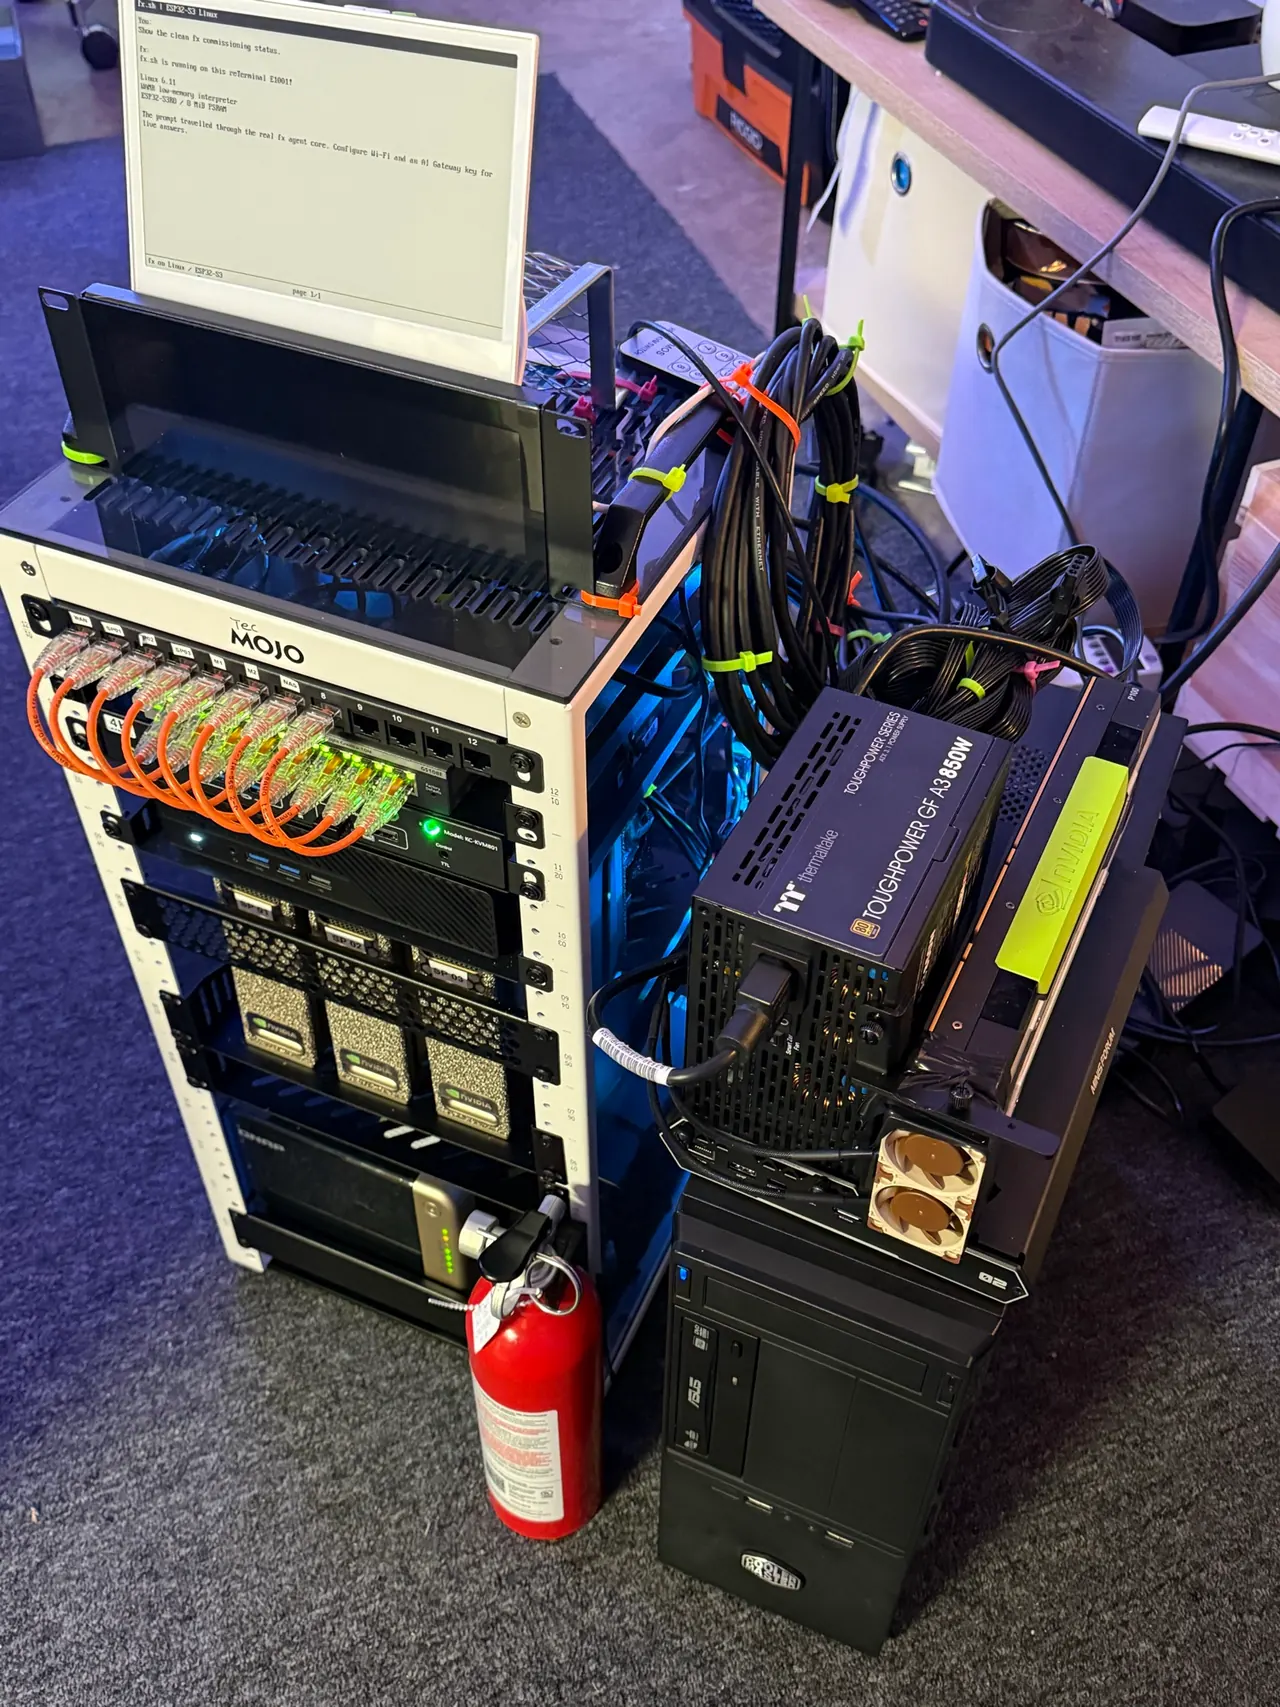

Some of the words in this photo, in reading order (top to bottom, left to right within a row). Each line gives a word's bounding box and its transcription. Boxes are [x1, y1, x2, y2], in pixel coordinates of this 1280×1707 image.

[166, 3, 196, 15] ESP32-S3
[199, 9, 218, 19] Linux
[138, 17, 152, 25] You:
[138, 27, 153, 35] Show
[156, 29, 168, 38] the
[170, 32, 189, 41] clean
[192, 35, 200, 43] fx
[203, 38, 251, 52] commissioning
[254, 45, 281, 55] status.
[140, 55, 158, 64] fx.sh
[161, 57, 169, 66] is
[171, 61, 197, 72] running
[211, 66, 226, 76] this
[229, 70, 266, 82] reTerminal
[140, 73, 158, 83] Linux
[161, 77, 176, 86] 6.11
[198, 93, 238, 106] interpreter
[208, 103, 227, 113] PSRAM
[143, 120, 157, 128] live
[160, 124, 188, 134] answers.
[142, 110, 153, 119] The
[156, 113, 177, 123] prompt
[180, 117, 213, 129] travelled
[216, 123, 242, 135] through
[245, 125, 256, 136] the
[259, 129, 274, 140] real
[277, 133, 286, 142] fx
[288, 137, 307, 145] agent
[310, 140, 330, 150] core.
[333, 143, 368, 156] Configure
[371, 150, 391, 160] Wi-Fi
[394, 155, 406, 163] and
[433, 161, 461, 174] Gateway
[464, 166, 477, 176] key
[481, 169, 493, 178] for
[148, 257, 155, 265] fx
[168, 262, 185, 271] Linux
[195, 266, 223, 279] ESP32-S3
[292, 288, 307, 298] page
[756, 525, 765, 572] ETHERNET
[229, 617, 258, 633] Tec
[231, 628, 305, 664] MOJO
[248, 667, 257, 676] M2
[320, 692, 327, 700] 8
[1127, 687, 1140, 701] P100
[356, 703, 364, 711] 9
[392, 714, 402, 723] 10
[430, 726, 440, 734] 11
[467, 737, 478, 746] 12
[878, 752, 887, 762] ATX
[888, 728, 902, 746] POWER
[897, 714, 909, 730] SUPPLY
[844, 736, 885, 795] TOUGHPOWER
[878, 711, 901, 738] SERIES
[938, 735, 974, 779] 850W
[928, 777, 951, 799] A3
[917, 797, 940, 820] GF
[435, 842, 453, 852] Control
[797, 829, 839, 883] thermaltake
[862, 820, 930, 920] TOUGHPOWER
[853, 920, 869, 934] 80
[349, 939, 362, 950] 02
[451, 972, 464, 983] 03
[979, 1271, 1008, 1290] 02
[688, 1376, 702, 1408] ASUS
